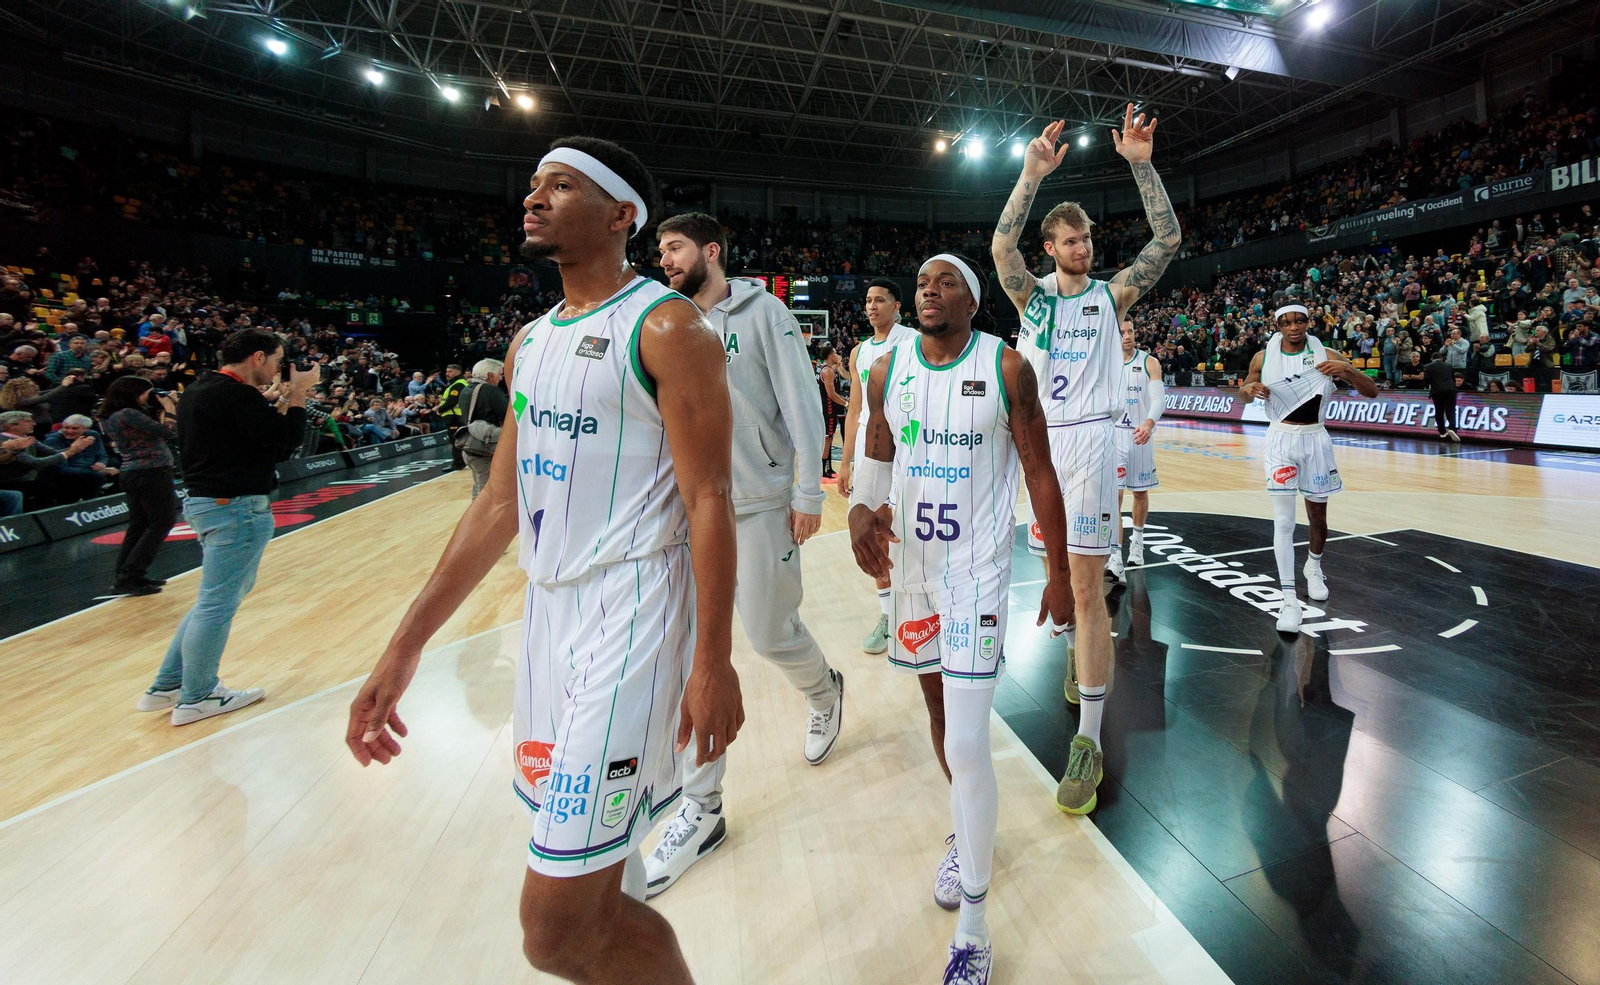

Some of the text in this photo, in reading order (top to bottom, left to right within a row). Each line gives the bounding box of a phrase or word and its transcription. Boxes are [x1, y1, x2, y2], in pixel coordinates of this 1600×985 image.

[1492, 176, 1533, 194] surne
[1427, 195, 1463, 211] Occident
[1376, 206, 1415, 222] vueling
[312, 256, 330, 264] UNA
[333, 258, 361, 267] CAUSA
[803, 275, 822, 283] bbk
[351, 313, 360, 322] B
[581, 341, 595, 350] liga
[1051, 374, 1069, 401] 2
[1178, 394, 1194, 411] DE
[1192, 395, 1234, 413] PLAGAS
[1121, 412, 1132, 427] 4
[1326, 401, 1508, 431] ONTROL DE PGAS
[923, 428, 984, 451] Unicaja
[906, 458, 970, 484] málaga
[82, 501, 130, 523] Occident
[915, 501, 961, 542] 55
[946, 617, 971, 636] má
[943, 627, 970, 652] laga
[551, 764, 592, 795] má
[609, 766, 632, 779] acb
